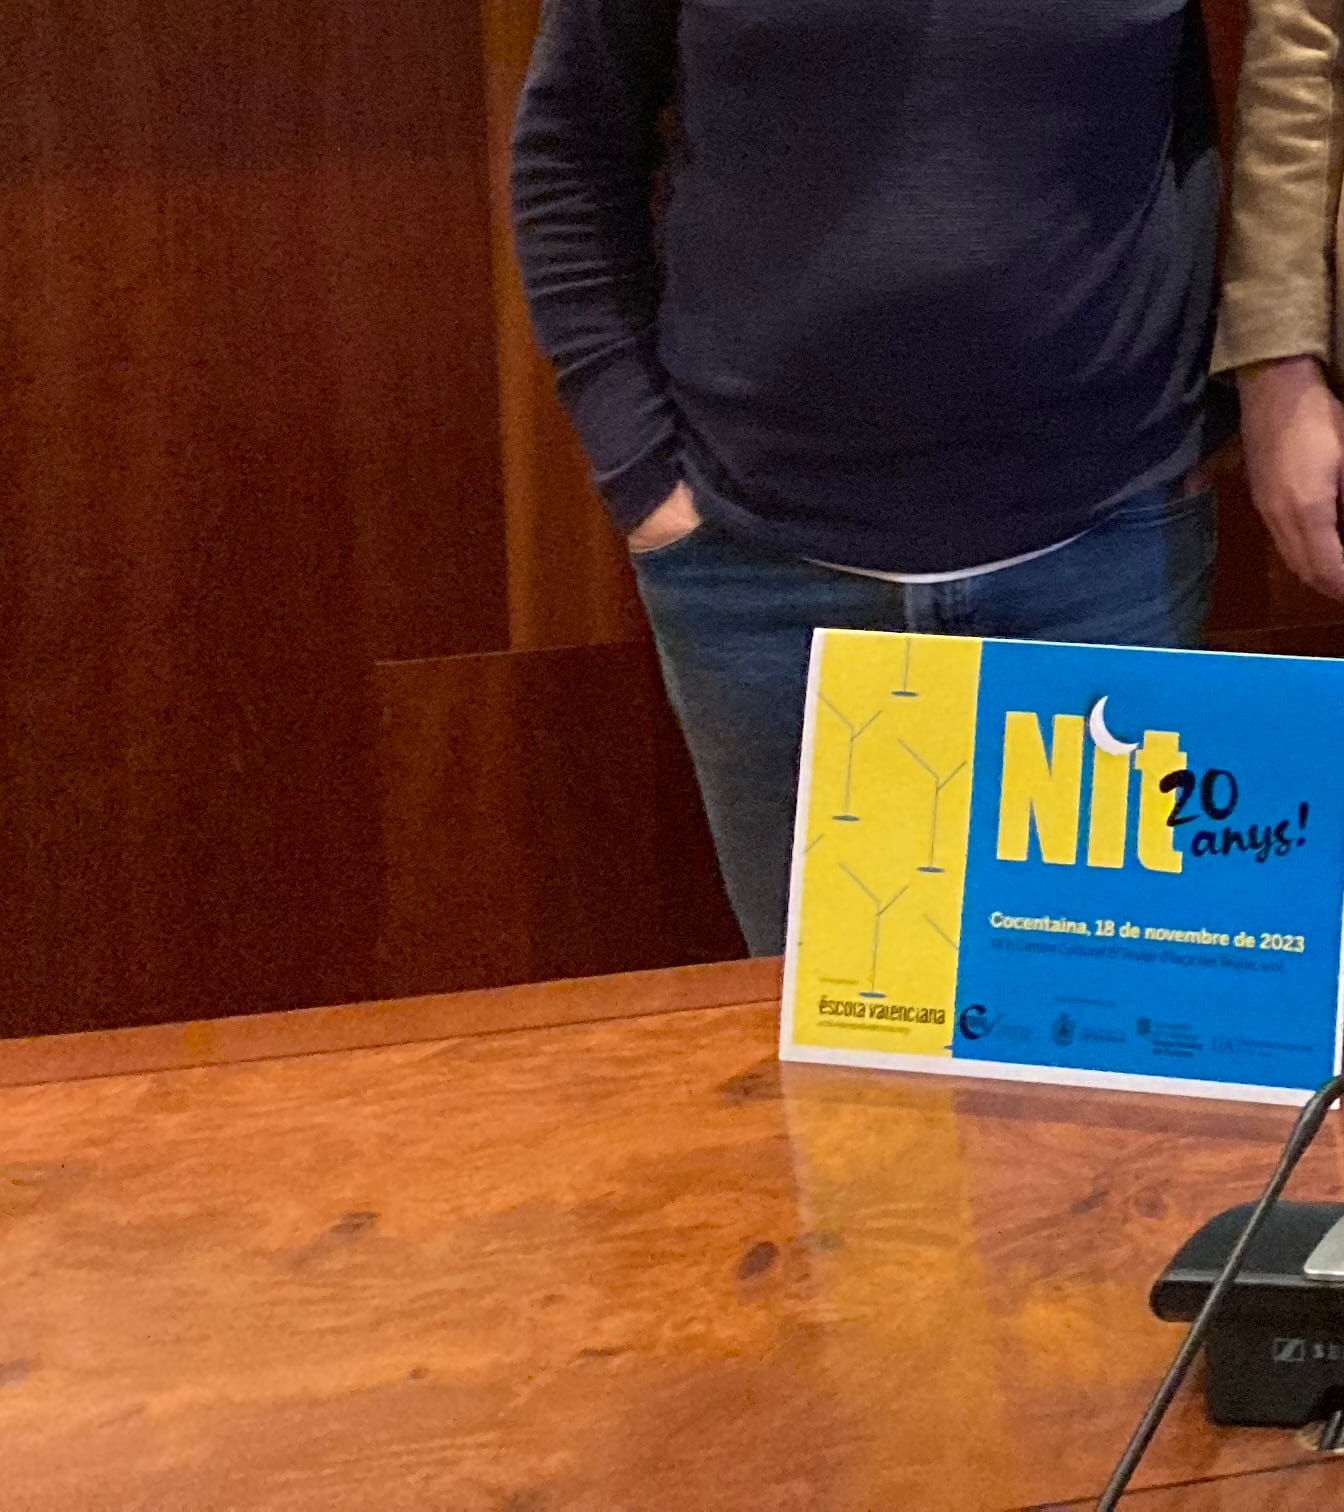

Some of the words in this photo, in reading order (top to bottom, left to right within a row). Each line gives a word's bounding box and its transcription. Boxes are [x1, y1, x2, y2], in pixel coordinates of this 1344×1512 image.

[996, 710, 1187, 874] Nit
[1159, 768, 1239, 829] 20
[1190, 801, 1310, 864] anys!
[989, 911, 1091, 936] Cocentaina,
[1095, 919, 1115, 937] 18
[1119, 921, 1140, 938] de
[1144, 925, 1230, 947] novembre
[1233, 931, 1255, 949] de
[1259, 933, 1305, 953] 2023
